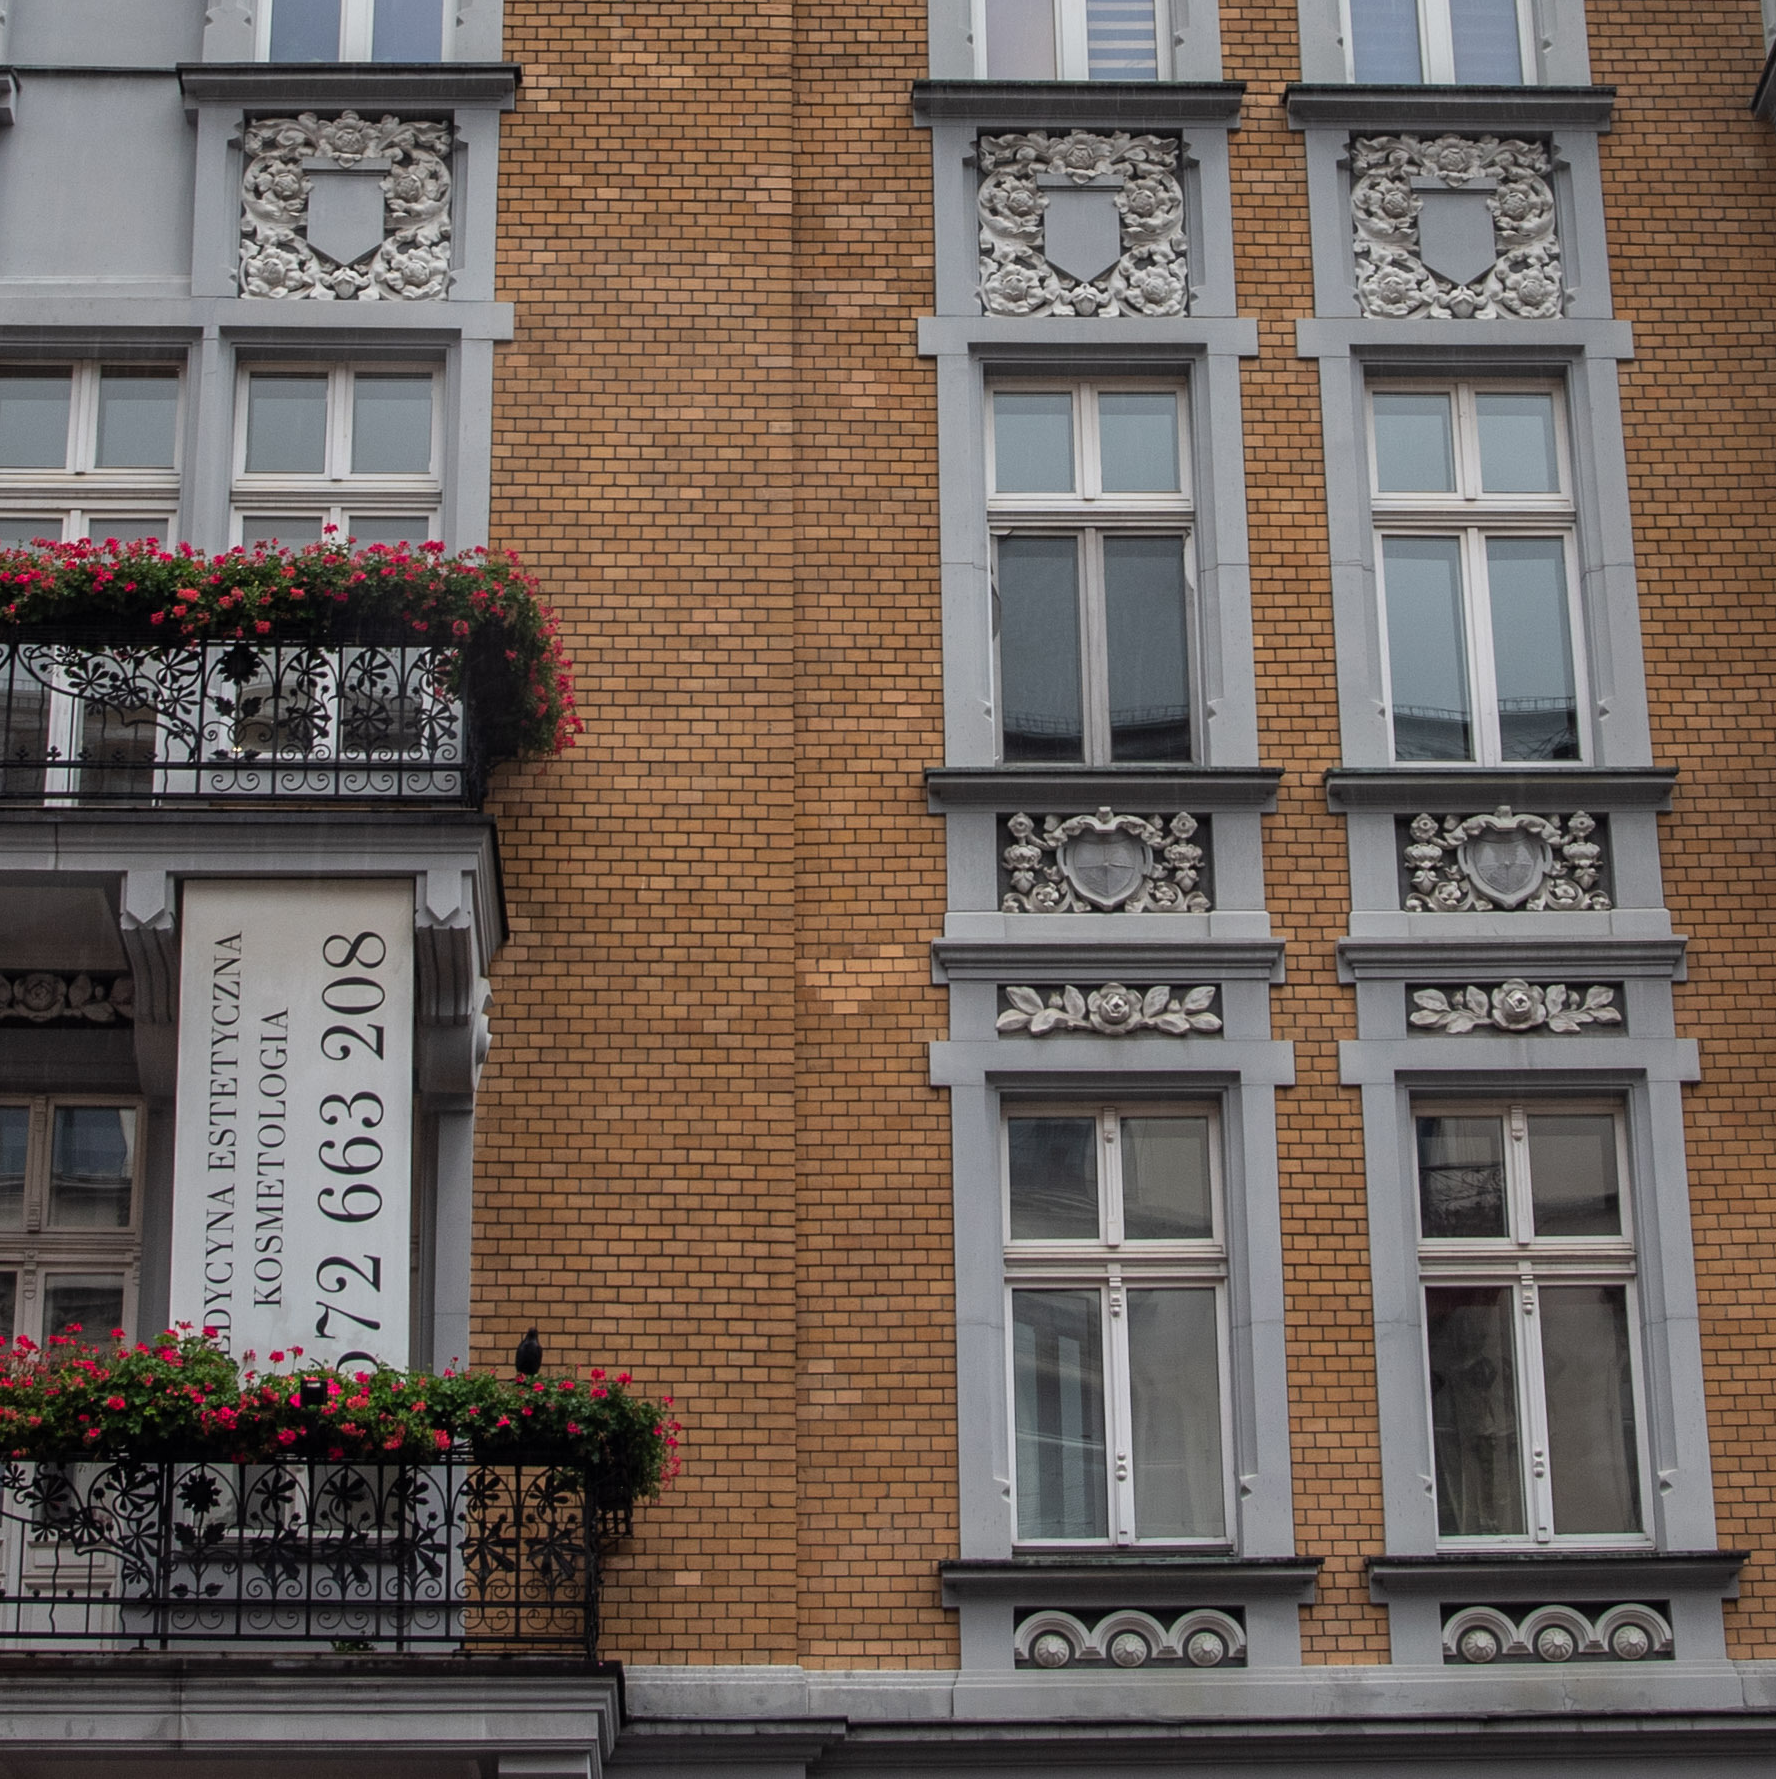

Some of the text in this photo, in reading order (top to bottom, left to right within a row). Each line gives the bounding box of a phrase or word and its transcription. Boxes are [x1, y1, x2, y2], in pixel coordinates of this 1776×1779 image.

[320, 931, 387, 1061] 208
[203, 930, 244, 1356] EDYCYNA ESTETYCZNA
[253, 1007, 290, 1309] KOSMETOLOGIA
[318, 1091, 384, 1223] 663
